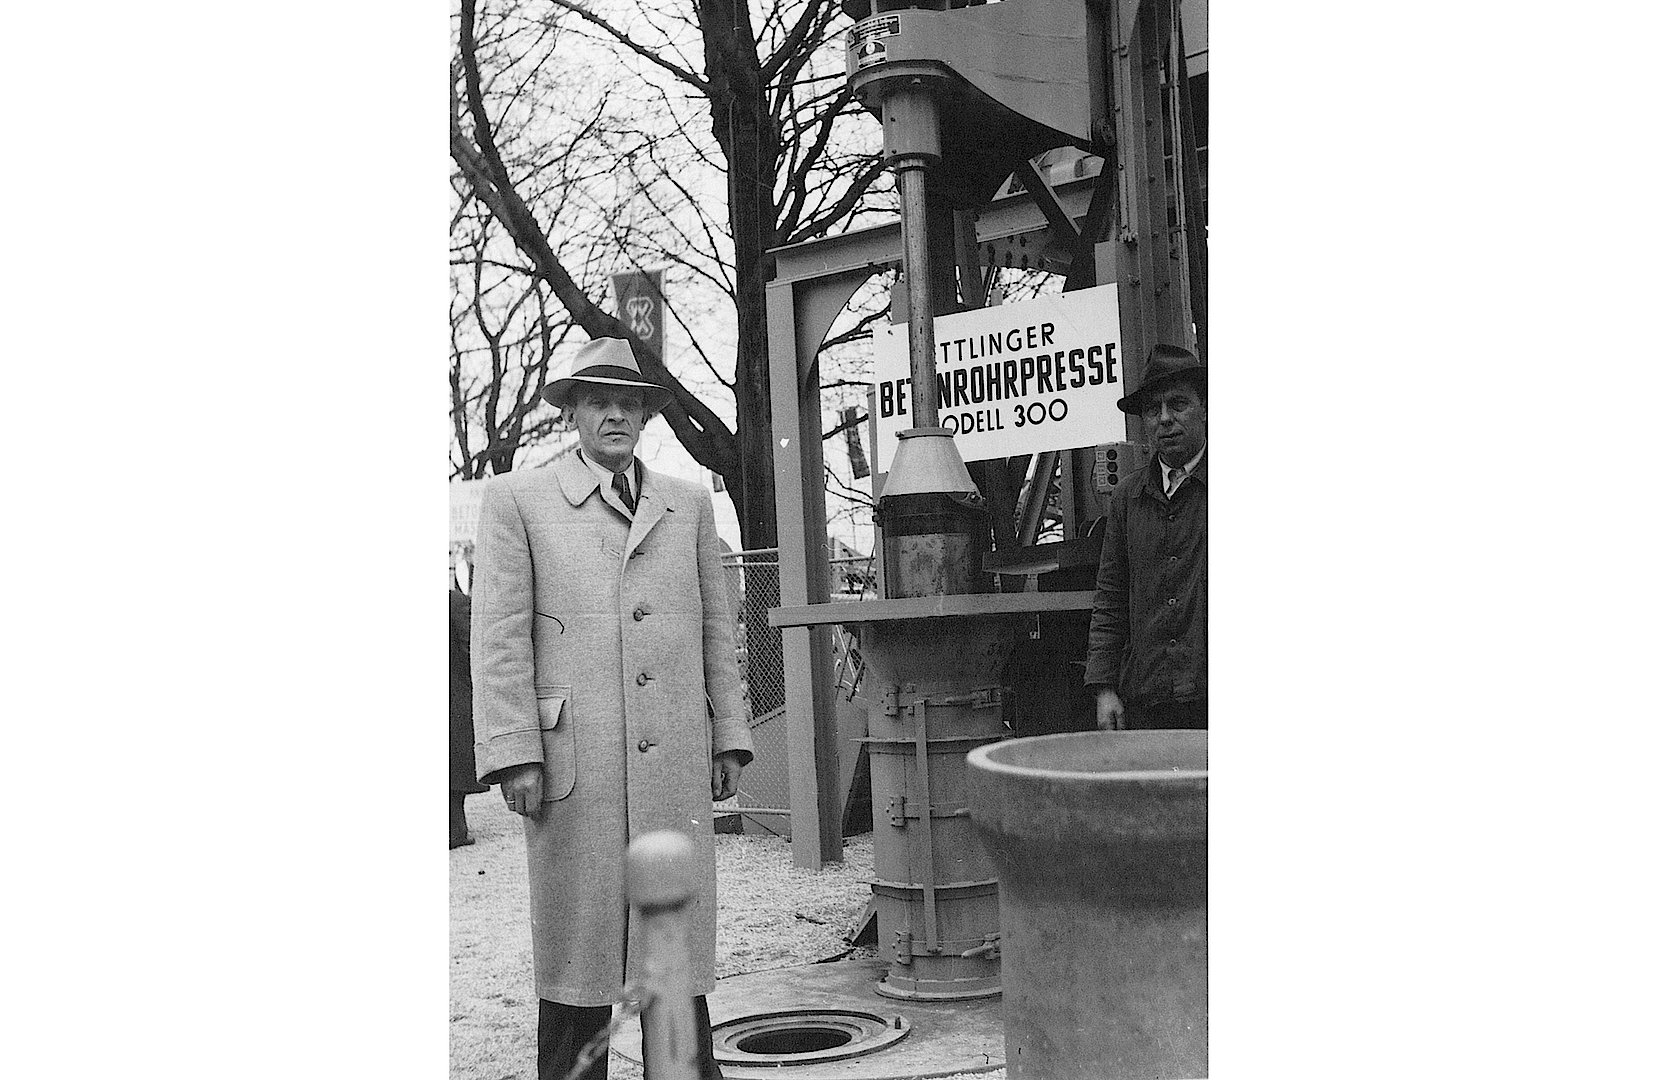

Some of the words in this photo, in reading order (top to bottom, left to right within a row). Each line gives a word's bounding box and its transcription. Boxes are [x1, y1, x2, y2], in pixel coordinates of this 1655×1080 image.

[935, 322, 1055, 364] TTLINGER
[880, 343, 1118, 418] BENROHRPRESSE
[941, 408, 1005, 436] ODELL
[1013, 398, 1068, 428] 300
